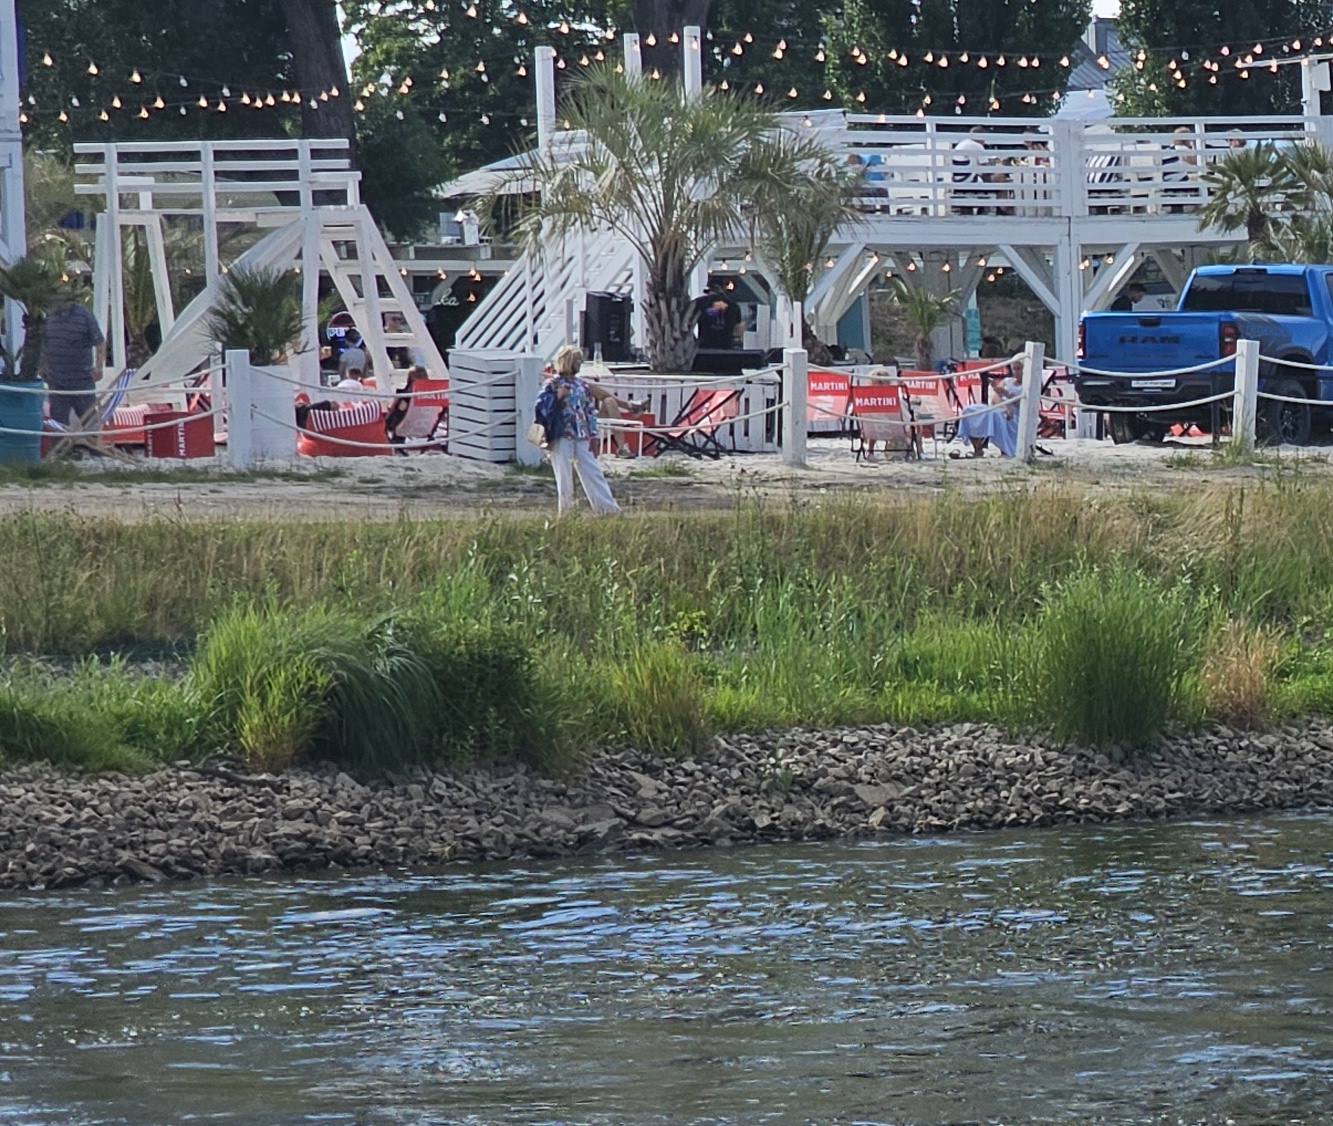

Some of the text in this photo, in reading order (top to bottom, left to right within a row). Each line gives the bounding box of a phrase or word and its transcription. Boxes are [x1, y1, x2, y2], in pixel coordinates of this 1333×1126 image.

[1118, 334, 1181, 344] RAM
[810, 381, 848, 391] MARTINI
[903, 380, 936, 390] MARTINI
[855, 397, 897, 407] MARTINI
